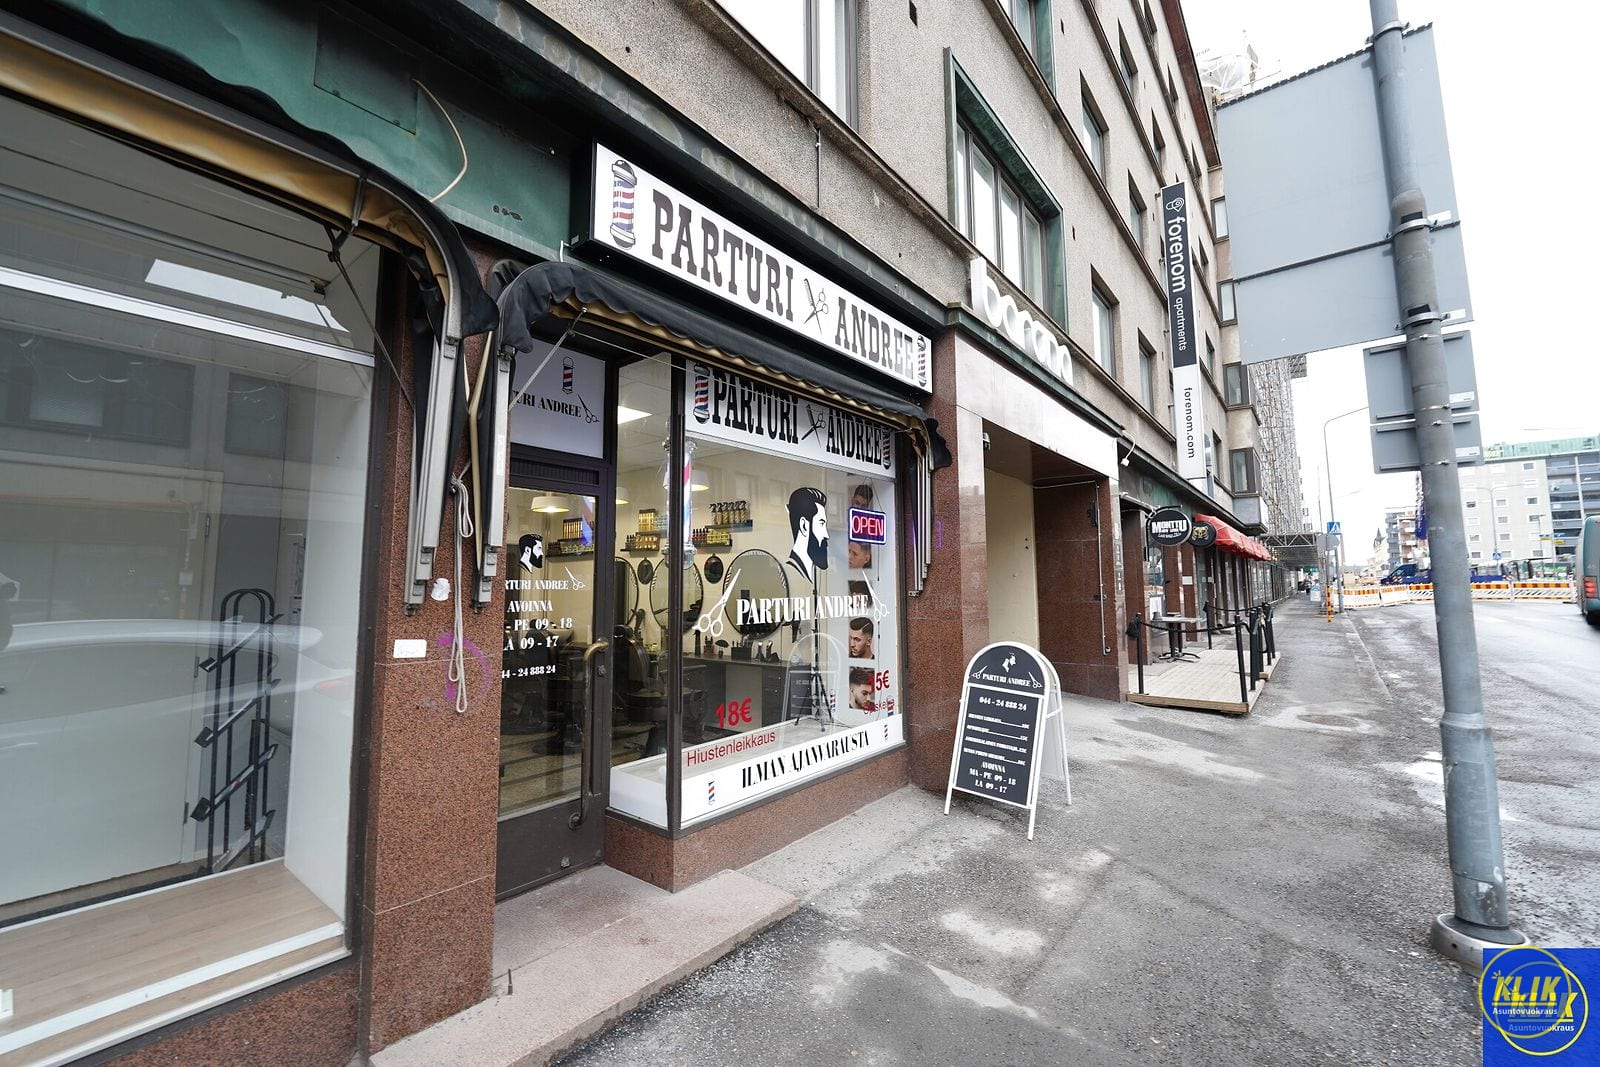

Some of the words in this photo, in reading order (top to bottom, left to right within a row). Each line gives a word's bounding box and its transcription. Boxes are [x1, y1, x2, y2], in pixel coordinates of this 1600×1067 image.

[1166, 216, 1186, 293] forenom
[651, 188, 794, 322] PARTURI
[834, 296, 914, 380] ANDREE
[1175, 297, 1187, 352] apartments
[537, 396, 582, 418] ANDREE
[711, 369, 800, 445] PARTURI
[826, 407, 883, 466] ANDREE
[1183, 387, 1195, 459] forenom.com
[852, 515, 884, 537] OPEN
[533, 579, 569, 590] ANDREE
[507, 600, 553, 612] AVOINNA
[735, 596, 812, 626] PARTURI
[814, 594, 869, 620] ANDREE
[514, 618, 530, 631] PE
[535, 618, 549, 630] 09
[560, 617, 573, 629] 18
[520, 637, 535, 650] 09
[546, 635, 560, 648] 17
[517, 667, 529, 677] 24
[529, 665, 545, 676] 888
[545, 664, 556, 674] 24
[982, 673, 1007, 683] PARTURI
[1007, 677, 1031, 687] ANDREE
[714, 697, 753, 729] 18€
[996, 699, 1005, 708] 24
[1018, 703, 1027, 711] 24
[686, 731, 776, 767] Hiustenleikkaus
[741, 755, 787, 789] ILMAN
[791, 730, 870, 772] AJANVARAUSTA
[974, 779, 983, 788] LA
[985, 782, 994, 790] 09
[999, 785, 1008, 794] 17
[983, 771, 993, 780] PE
[993, 774, 1003, 783] 09
[1008, 777, 1017, 786] 18
